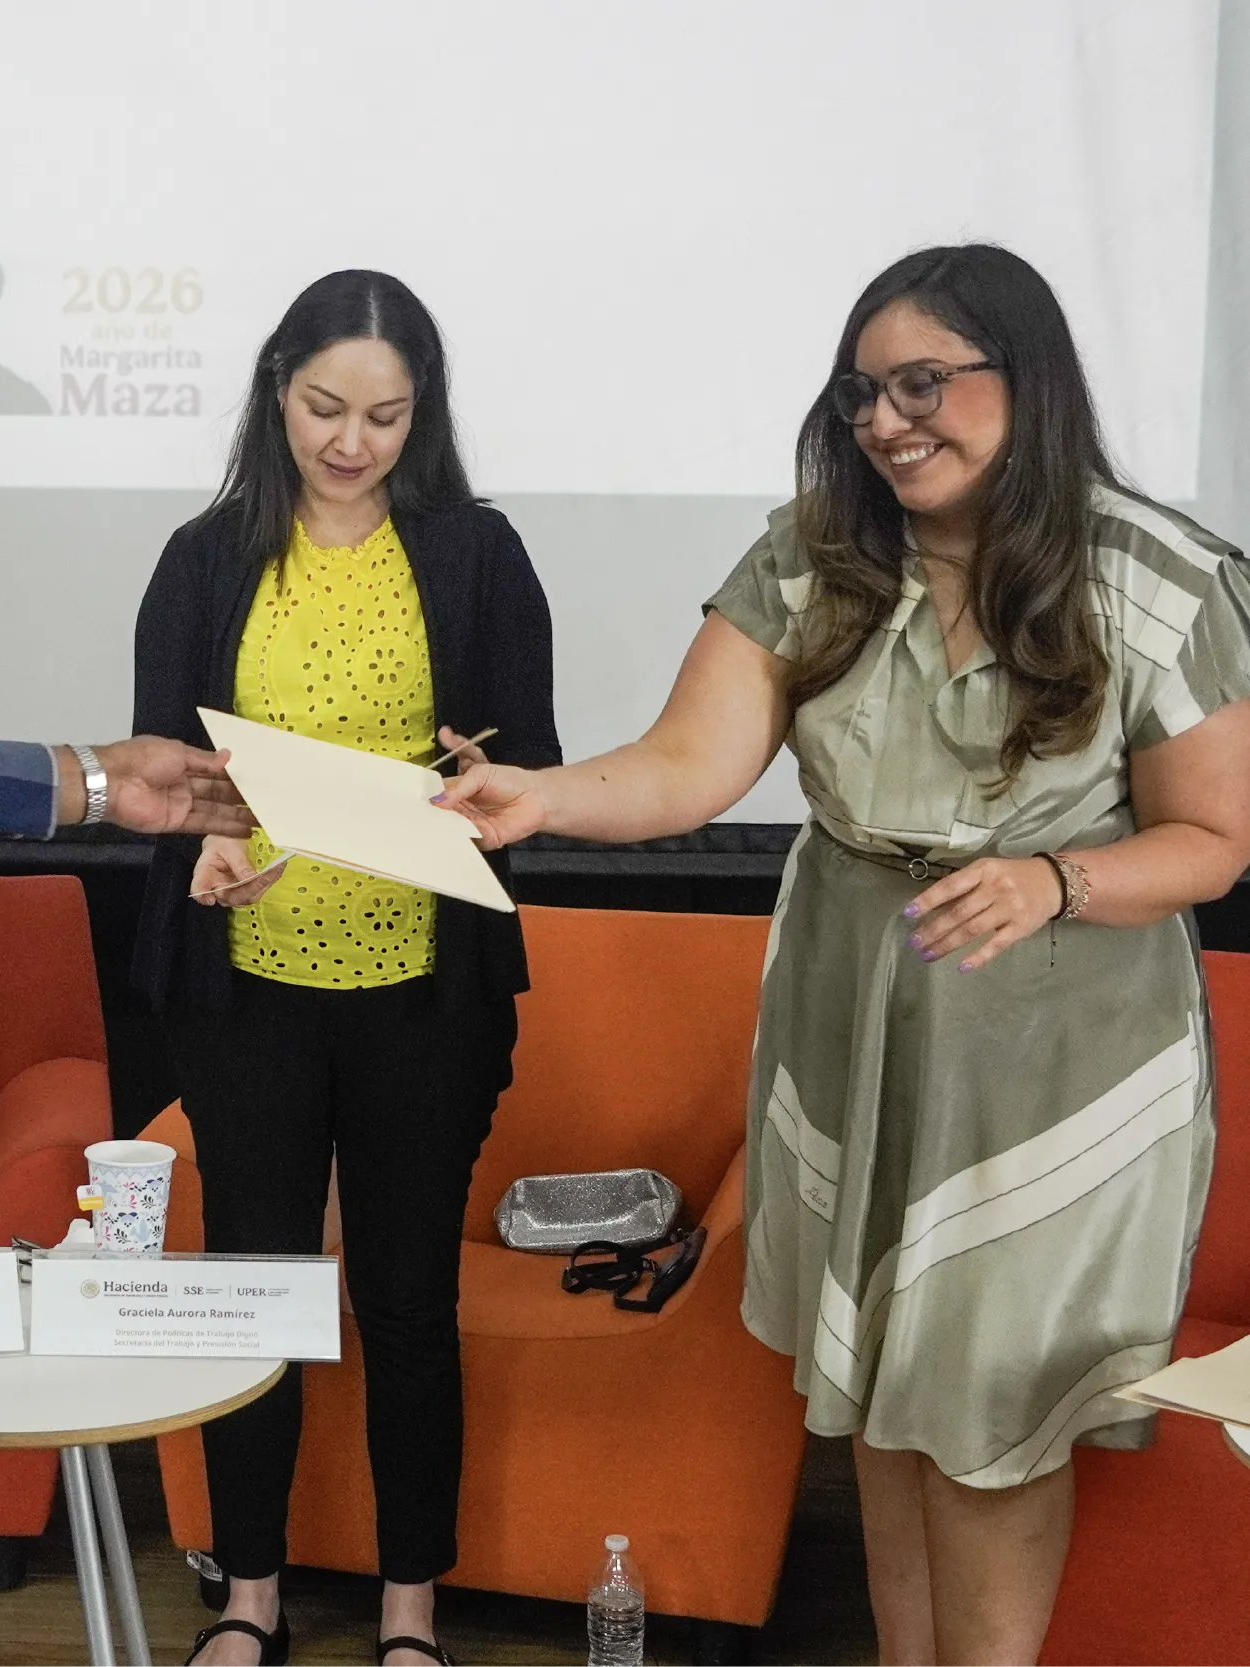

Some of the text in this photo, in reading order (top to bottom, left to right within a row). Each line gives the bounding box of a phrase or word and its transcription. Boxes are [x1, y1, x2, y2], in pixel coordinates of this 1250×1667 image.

[61, 265, 204, 315] 2026
[143, 319, 173, 340] de
[59, 344, 203, 377] Margarita
[59, 371, 202, 418] Maza
[104, 1281, 168, 1293] Hacienda
[183, 1286, 204, 1295] SSE
[237, 1287, 267, 1297] UPER
[118, 1307, 256, 1319] Graciela Aurora Ramírez
[115, 1329, 150, 1337] Directora
[152, 1329, 161, 1337] de
[195, 1330, 205, 1338] de
[207, 1330, 235, 1340] Trabajo
[153, 1340, 165, 1348] del
[167, 1340, 195, 1350] Trabajo
